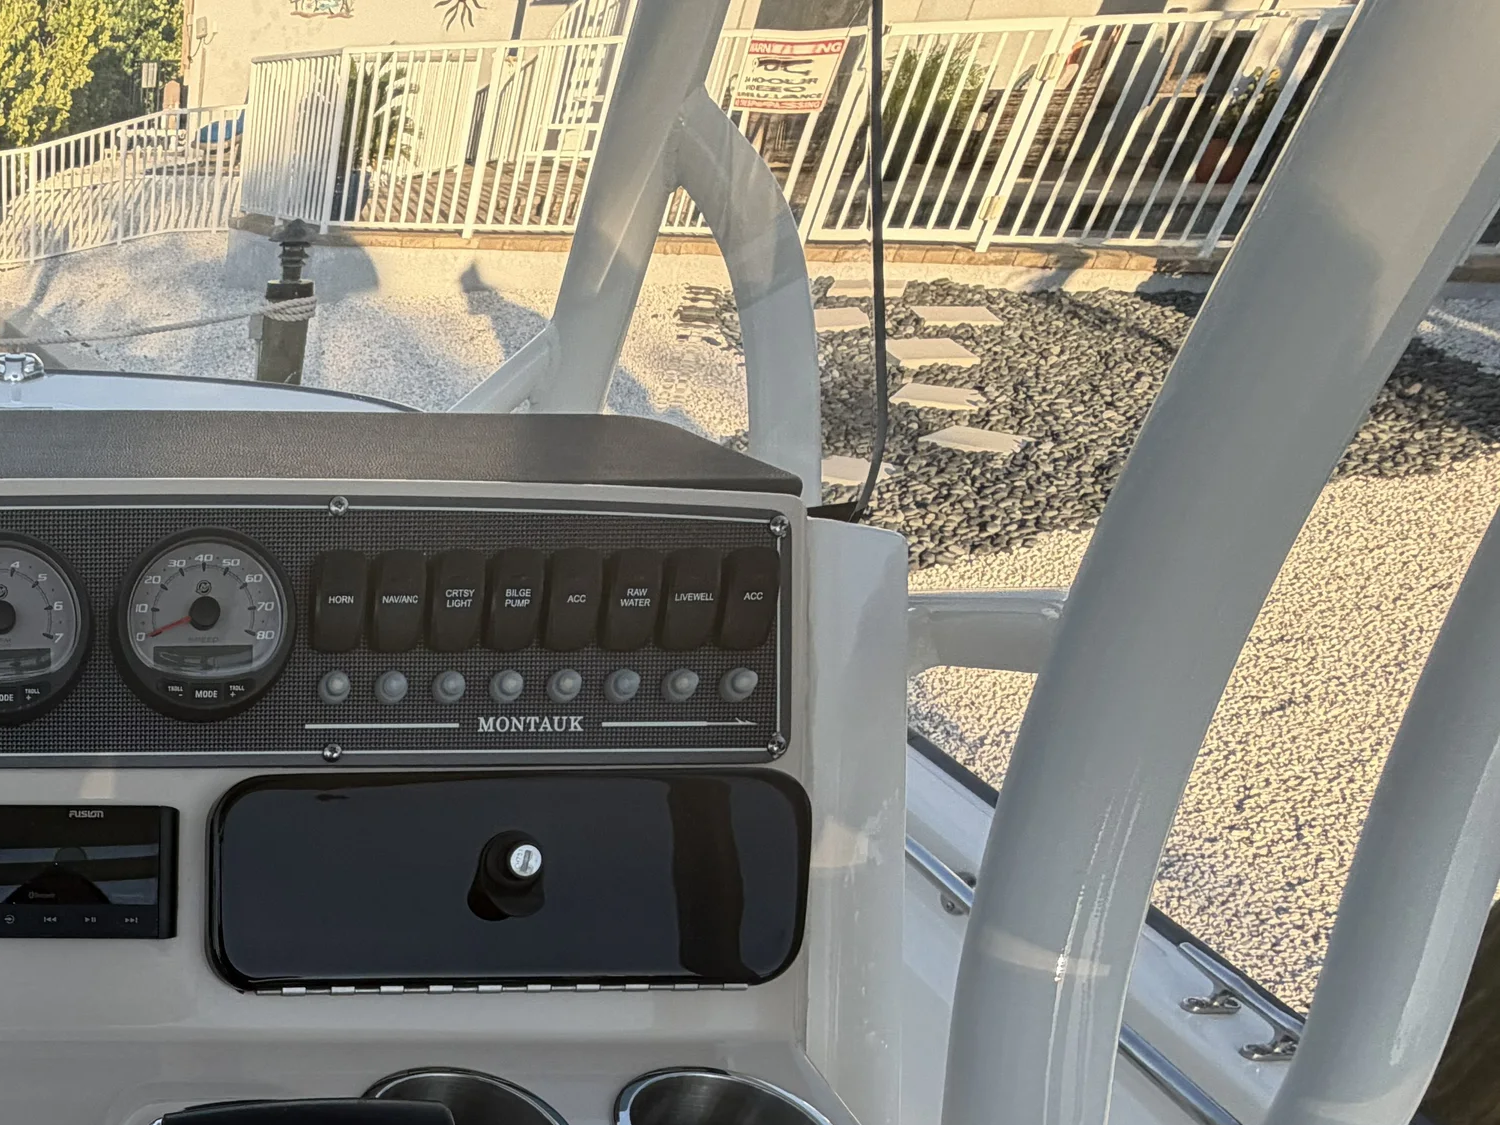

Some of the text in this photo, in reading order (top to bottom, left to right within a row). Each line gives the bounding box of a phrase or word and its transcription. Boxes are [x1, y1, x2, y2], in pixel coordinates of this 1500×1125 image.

[194, 554, 213, 562] 40
[167, 559, 186, 567] 30
[38, 573, 47, 581] 5
[144, 575, 161, 584] 20
[245, 574, 263, 583] 60
[445, 589, 475, 598] CRTSY
[505, 588, 532, 597] BILGE
[627, 588, 649, 597] RAW
[675, 592, 714, 601] LIVEWELL
[743, 592, 763, 601] ACC
[328, 595, 354, 604] HORN
[382, 595, 419, 604] NAV/ANC
[567, 594, 586, 603] ACC
[620, 598, 650, 607] WATER
[54, 601, 63, 610] 6
[135, 603, 148, 613] 10
[257, 601, 275, 612] 70
[446, 599, 472, 608] LIGHT
[505, 599, 530, 608] PUMP
[54, 633, 64, 643] 7
[136, 632, 145, 641] 0
[256, 630, 275, 640] 80
[195, 690, 218, 698] MODE
[477, 716, 584, 733] MONTAUK
